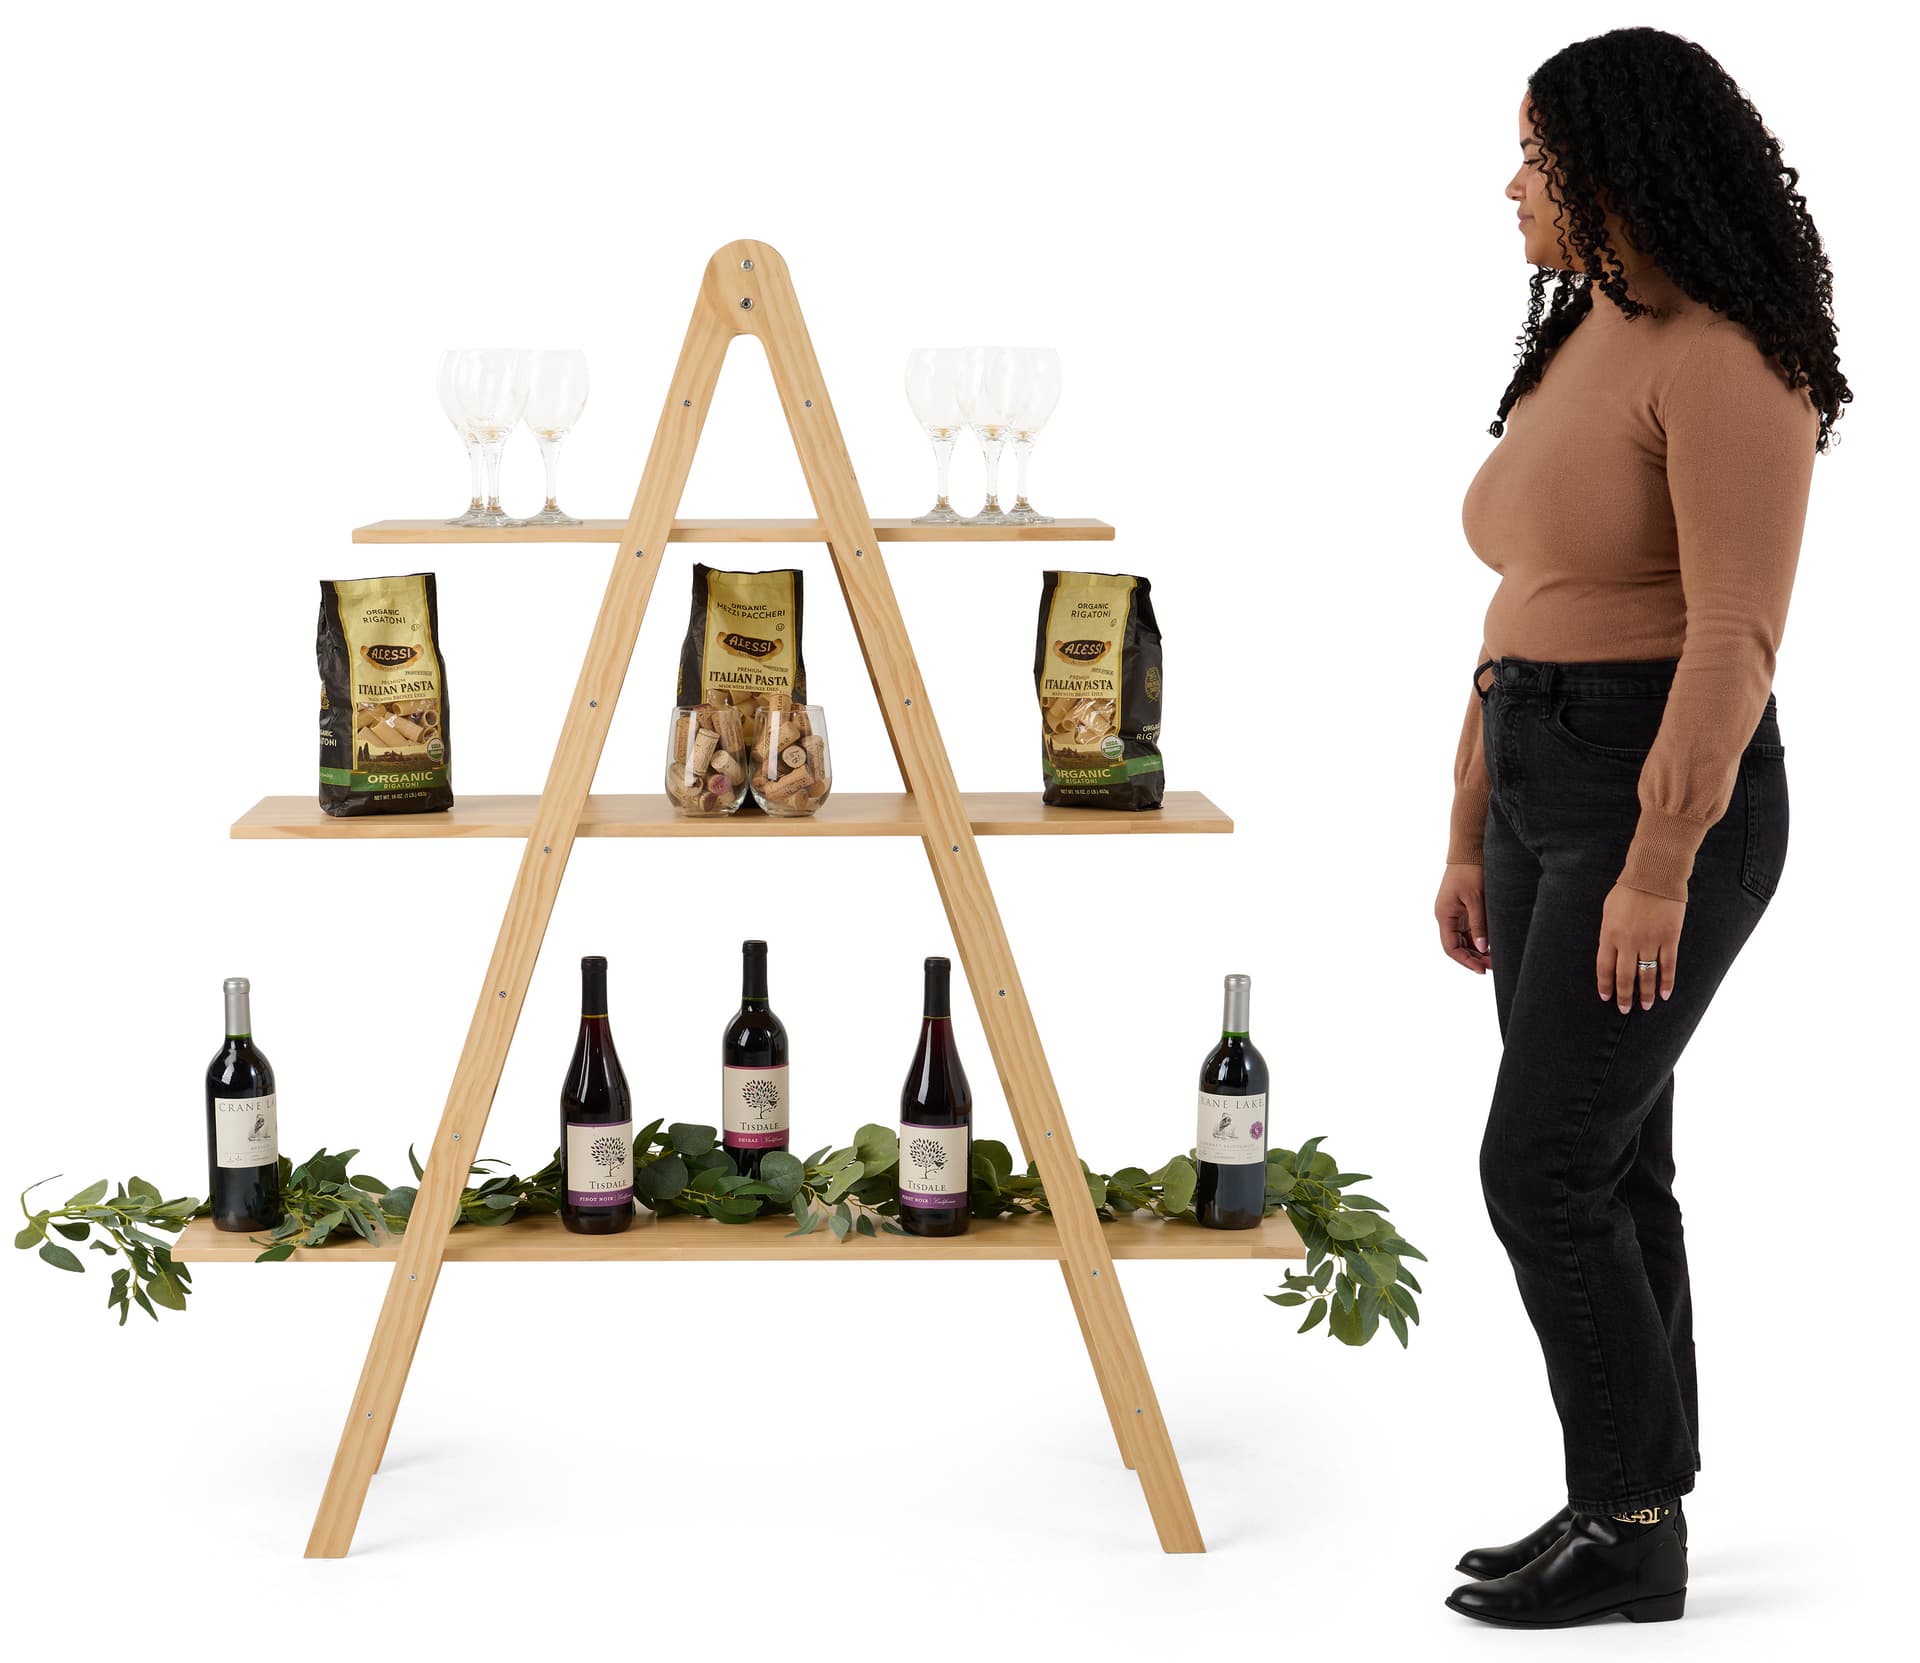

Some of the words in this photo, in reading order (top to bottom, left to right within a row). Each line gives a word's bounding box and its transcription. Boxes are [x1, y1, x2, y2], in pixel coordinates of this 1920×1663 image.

[717, 602, 740, 617] MEZZI
[741, 609, 785, 619] PACCHERI
[731, 603, 767, 611] ORGANIC
[1077, 602, 1109, 610] ORGANIC
[366, 608, 400, 616] ORGANIC
[1071, 610, 1111, 619] RIGATONI
[362, 615, 406, 625] RIGATONI
[729, 635, 771, 652] ALESSI
[1064, 643, 1104, 655] ALESSI
[371, 648, 412, 660] ALESSI
[737, 666, 762, 674] PREMIUM
[709, 671, 752, 684] ITALIAN
[755, 674, 788, 686] PASTA
[359, 684, 398, 695] ITALIAN
[400, 680, 434, 693] PASTA
[1045, 679, 1083, 690] ITALIAN
[1083, 679, 1113, 690] PASTA
[367, 771, 434, 784] ORGANIC
[1055, 768, 1111, 779] ORGANIC
[383, 781, 419, 789] RIGATONI
[219, 1101, 262, 1112] CRANE
[1236, 1098, 1264, 1109] LAKE
